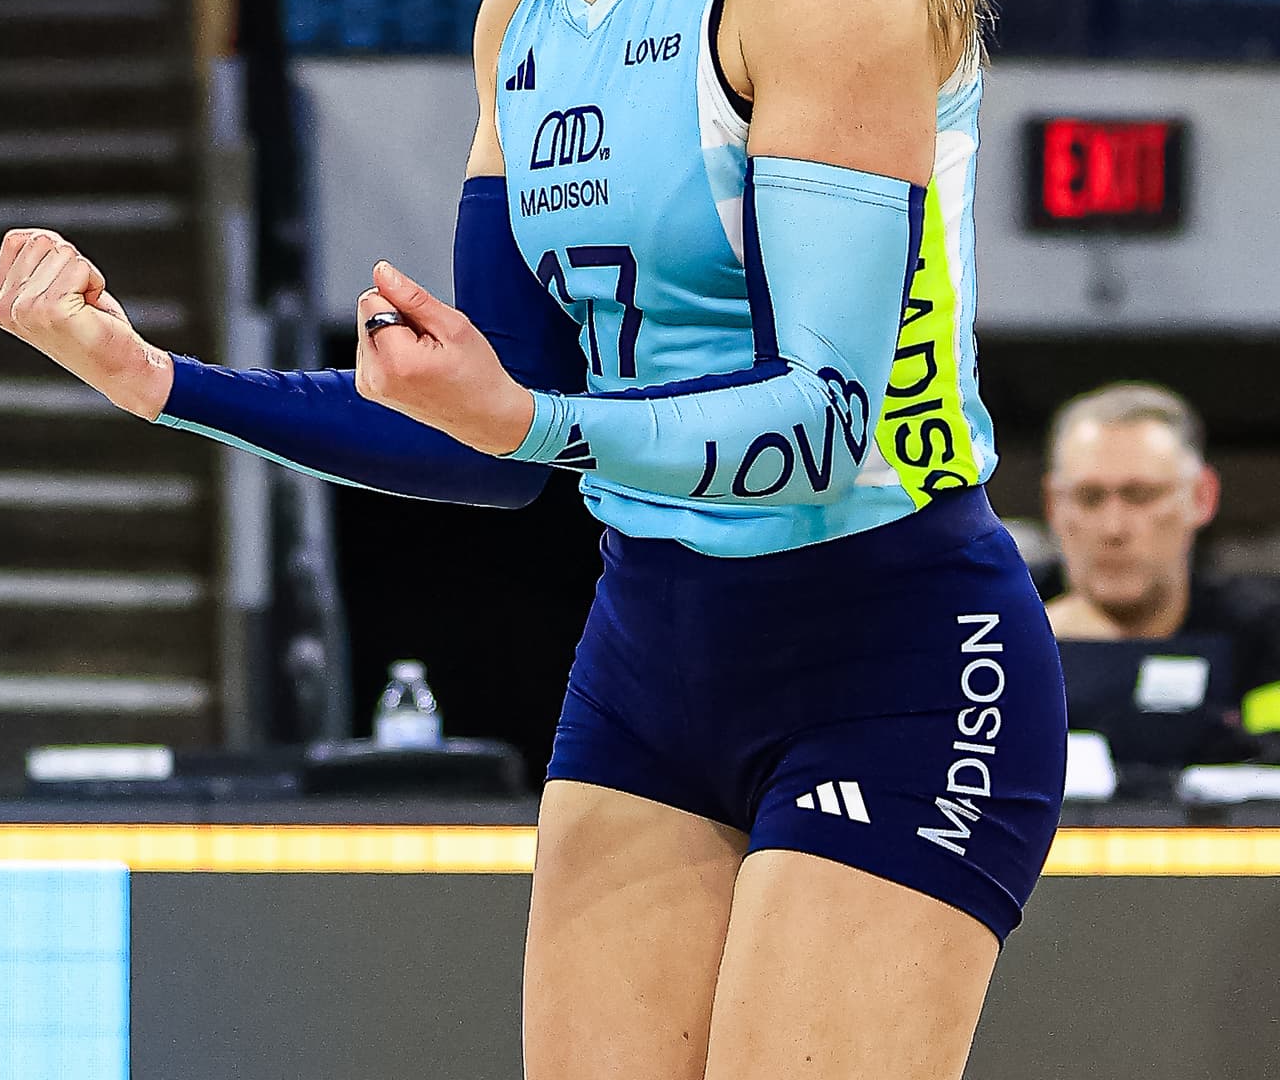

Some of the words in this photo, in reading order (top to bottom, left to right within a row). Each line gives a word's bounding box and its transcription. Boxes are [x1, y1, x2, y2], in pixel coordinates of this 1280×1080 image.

[624, 32, 682, 66] LOVB
[520, 177, 610, 218] MADISON
[536, 244, 644, 379] 17
[690, 365, 870, 498] LOVB
[916, 613, 1006, 856] MDISON
